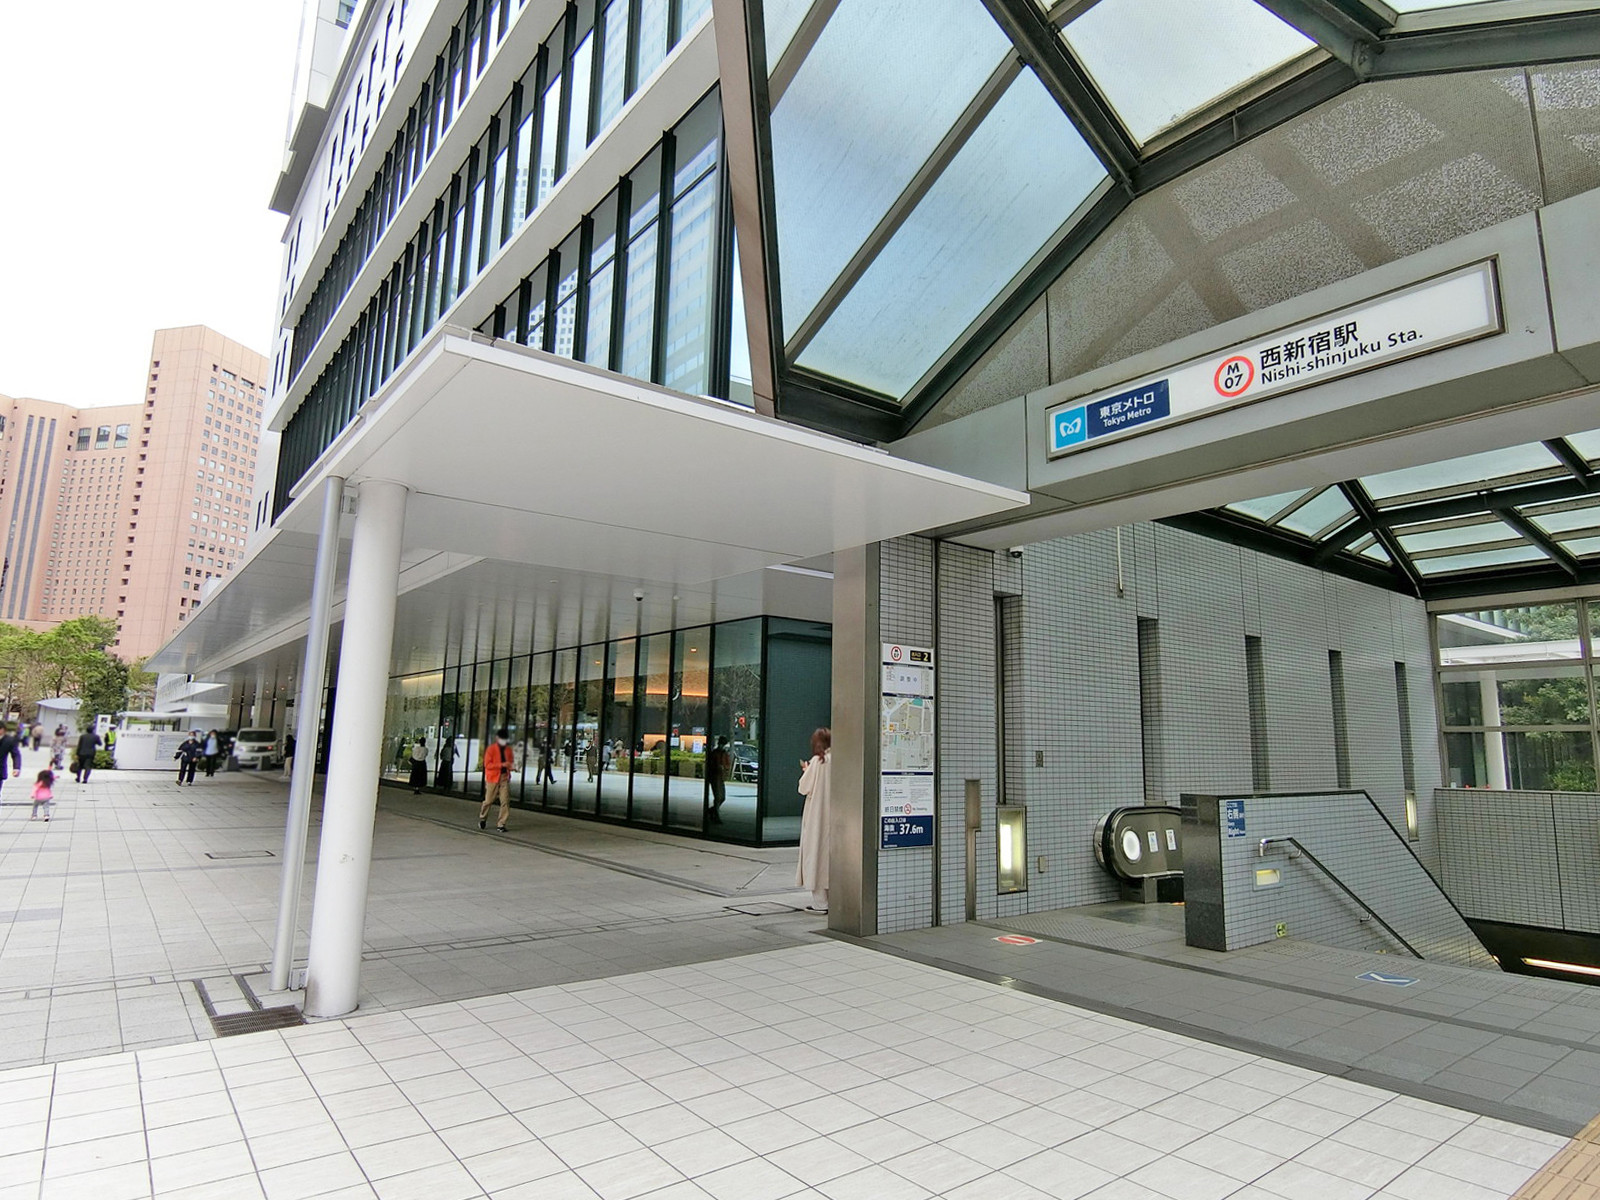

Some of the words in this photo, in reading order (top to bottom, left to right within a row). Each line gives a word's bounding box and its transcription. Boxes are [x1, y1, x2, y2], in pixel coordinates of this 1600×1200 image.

[1259, 321, 1359, 371] 西新宿駅
[1261, 338, 1381, 385] Nishi-shinjuku
[1388, 329, 1423, 348] Sta.
[1227, 362, 1240, 376] M
[1224, 374, 1244, 390] 07
[1099, 391, 1155, 419] 東京メトロ
[1103, 413, 1126, 428] Tokyo
[1127, 406, 1152, 420] Metro
[923, 652, 928, 661] 2
[899, 823, 924, 835] 37.6m
